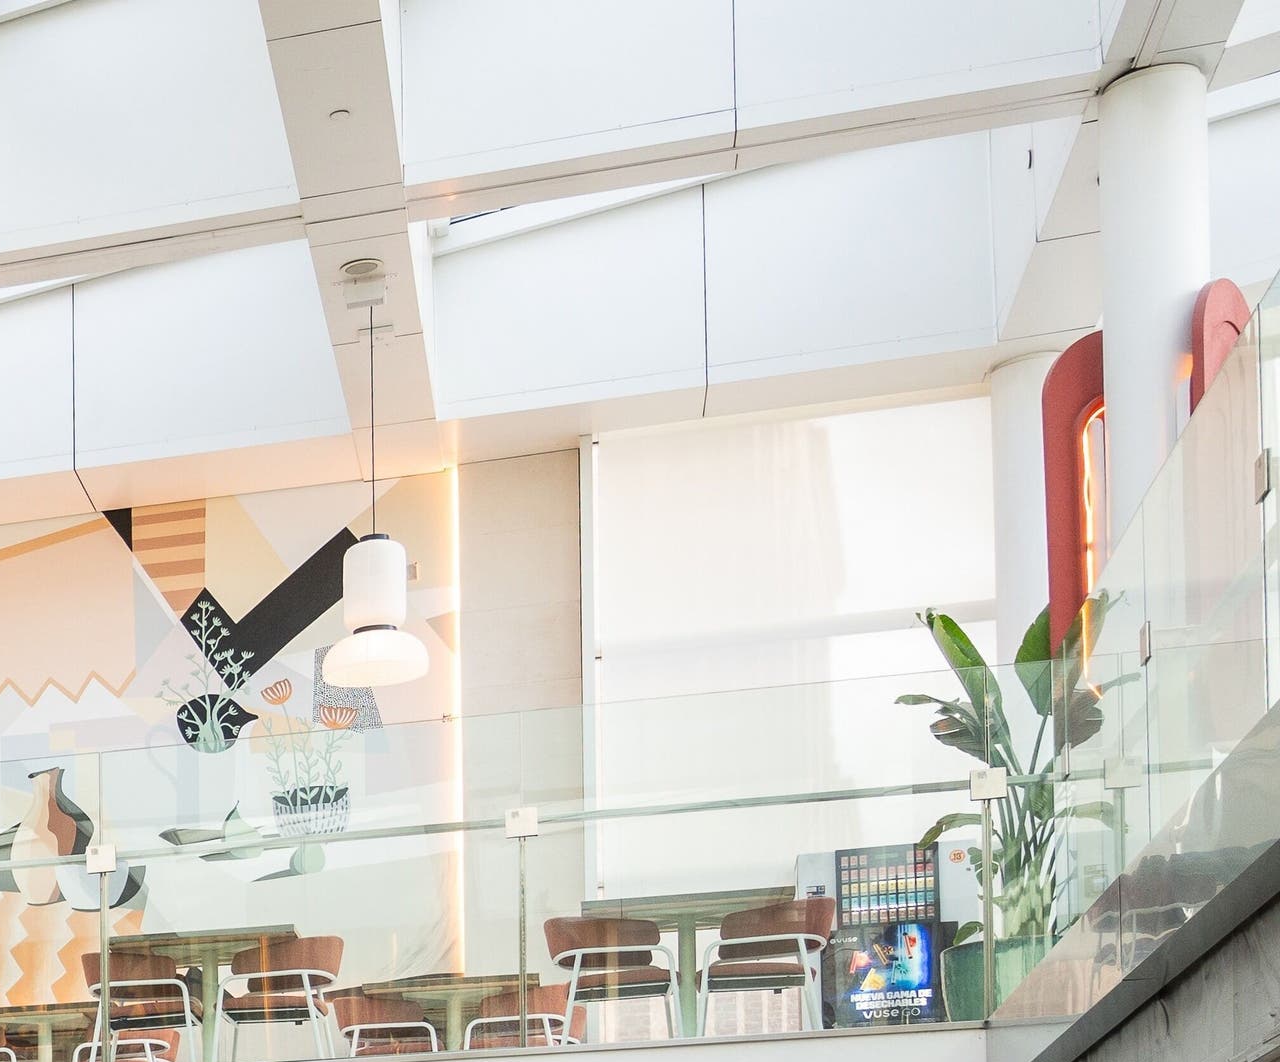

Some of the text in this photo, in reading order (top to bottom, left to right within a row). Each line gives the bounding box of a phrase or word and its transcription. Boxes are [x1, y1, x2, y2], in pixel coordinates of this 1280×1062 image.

[850, 988, 933, 1003] NUEVA GAMA DE
[855, 997, 928, 1011] DESECHABLES
